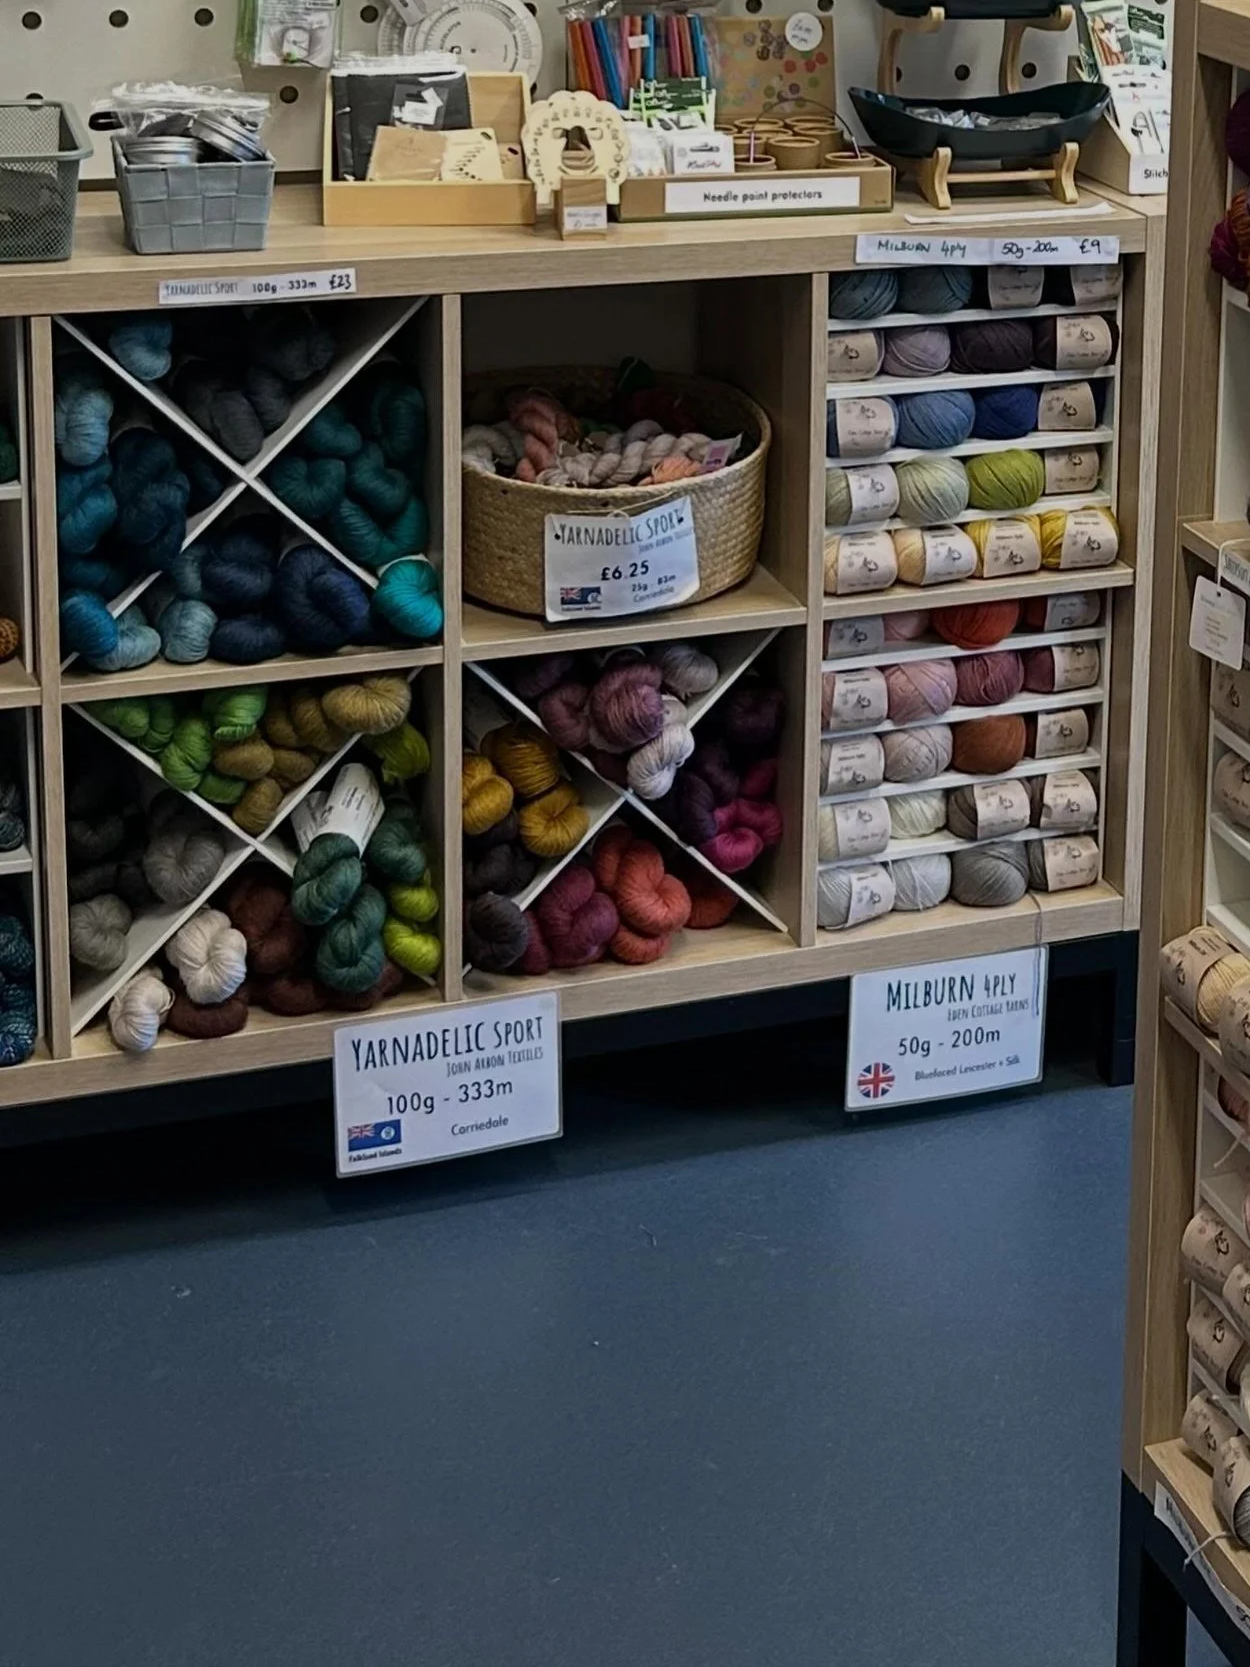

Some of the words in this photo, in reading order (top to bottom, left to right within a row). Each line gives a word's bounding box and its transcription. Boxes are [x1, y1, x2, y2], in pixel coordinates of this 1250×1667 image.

[703, 189, 739, 203] Needle
[742, 189, 769, 204] point
[771, 188, 823, 203] protectors
[877, 239, 932, 254] MILBURN
[940, 242, 968, 259] 4ply
[1078, 239, 1102, 255] £9
[252, 282, 278, 295] 100g
[328, 273, 352, 291] £23
[560, 522, 643, 547] YARNADELIC
[646, 508, 681, 540] SPORT
[600, 559, 650, 582] £6.25
[631, 583, 649, 593] 25g
[886, 973, 975, 1013] MILBURN
[983, 972, 1017, 999] 4PLY
[947, 1006, 970, 1023] EDEN
[971, 1000, 1004, 1019] COTTAGE
[351, 1020, 487, 1073] YARNADELIC
[492, 1015, 544, 1049] SPORT
[897, 1035, 932, 1059] 50g
[951, 1026, 1001, 1049] 200m
[446, 1060, 472, 1078] JOHN
[473, 1054, 505, 1072] ARBON
[507, 1046, 544, 1066] TEXTILES
[914, 1065, 958, 1082] Bluefaced
[958, 1060, 997, 1075] Leicester
[386, 1091, 436, 1116] 100g
[457, 1078, 514, 1104] 333m
[450, 1113, 509, 1137] Corriedale
